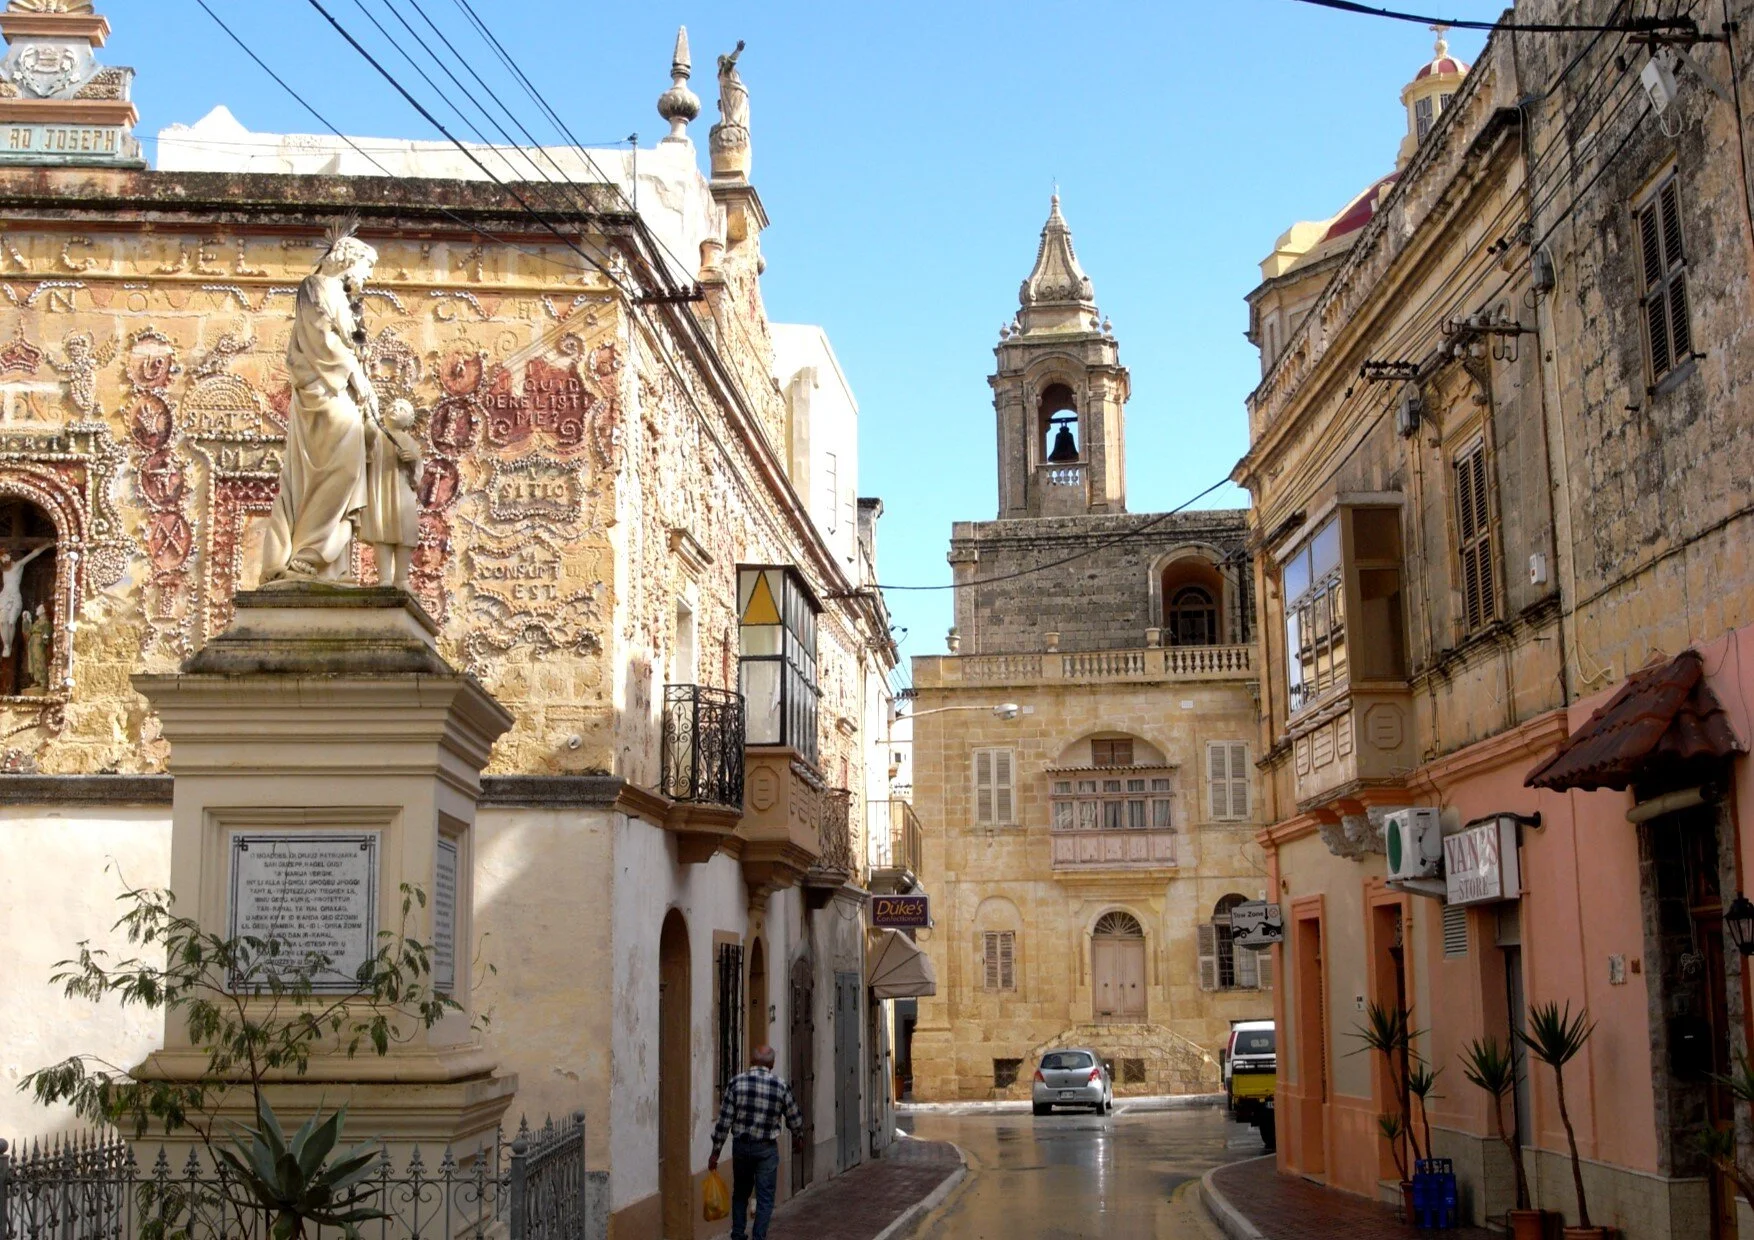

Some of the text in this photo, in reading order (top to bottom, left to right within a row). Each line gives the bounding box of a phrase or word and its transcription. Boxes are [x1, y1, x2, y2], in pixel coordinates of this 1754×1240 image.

[45, 129, 116, 150] JOSEPH
[502, 482, 565, 499] SITIO
[513, 583, 558, 600] EST
[1446, 826, 1499, 875] YAN'S
[1458, 876, 1489, 900] STORE
[877, 900, 924, 915] Duke's
